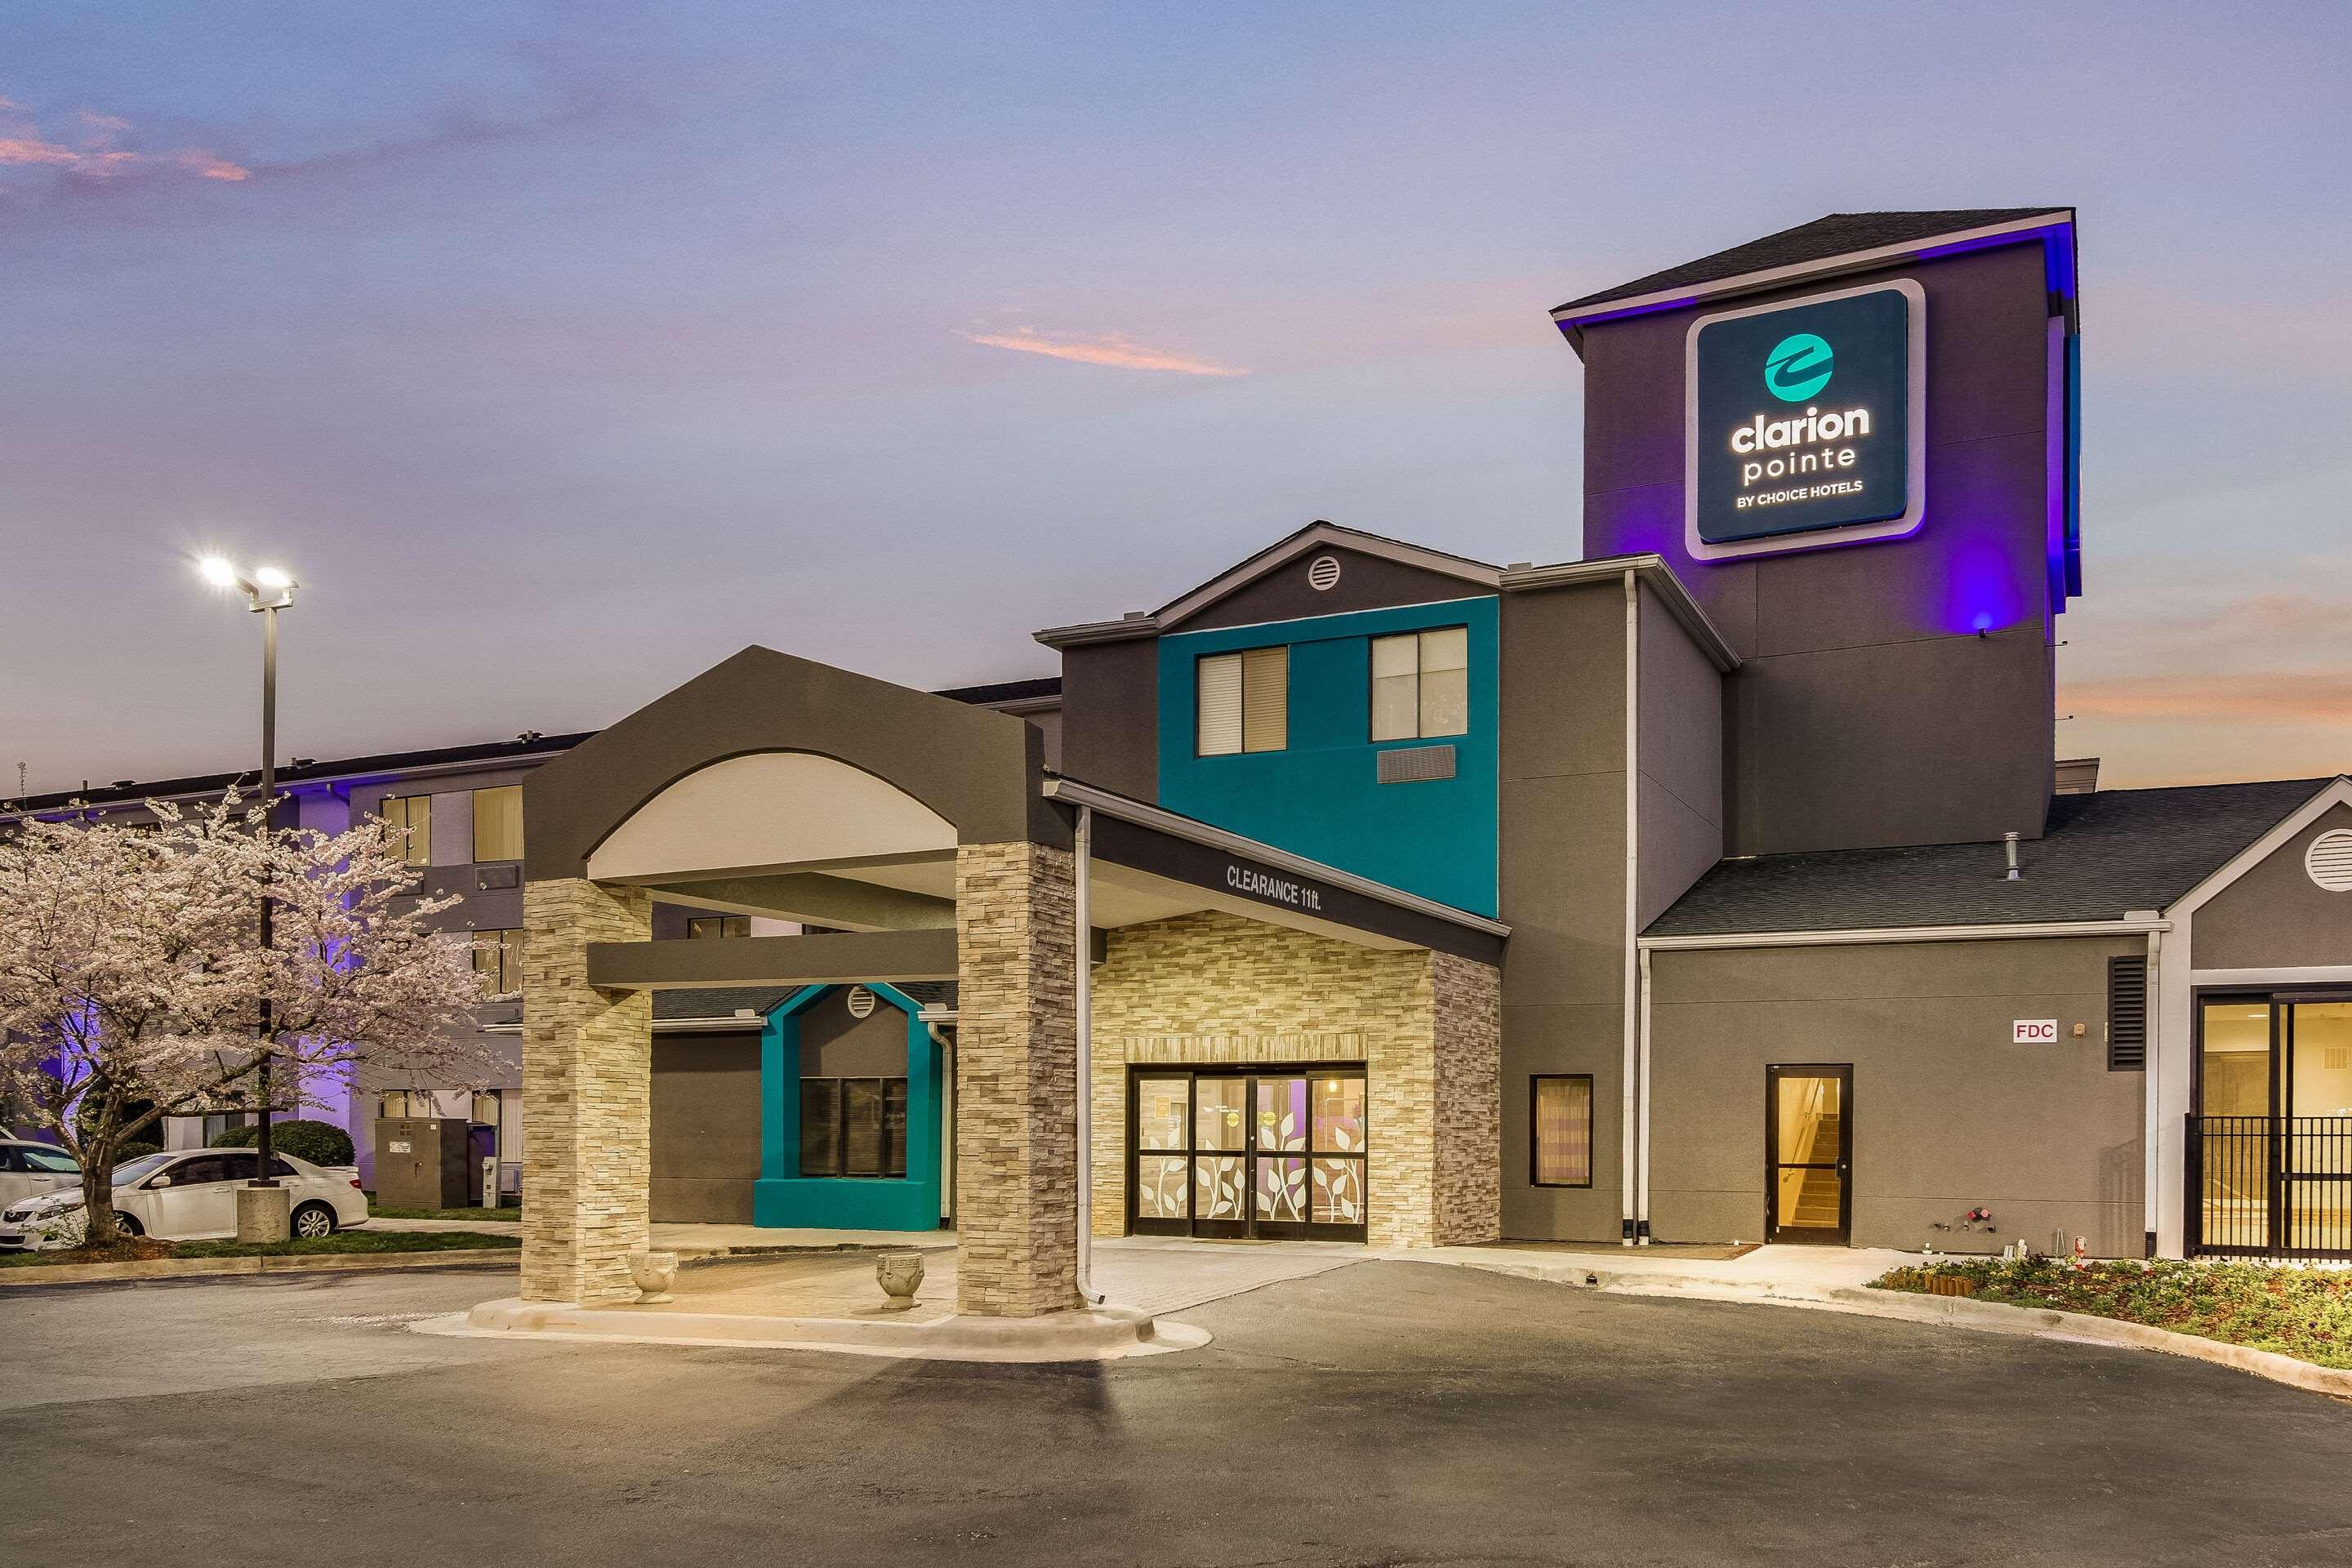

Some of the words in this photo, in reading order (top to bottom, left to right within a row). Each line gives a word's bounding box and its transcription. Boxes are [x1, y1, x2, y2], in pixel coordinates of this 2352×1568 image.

[1731, 407, 1869, 453] clarion
[1744, 448, 1855, 487] pointe
[1737, 495, 1755, 508] BY
[1757, 488, 1808, 506] CHOICE
[1811, 480, 1863, 497] HOTELS
[1227, 865, 1298, 904] CLEARANCE
[1301, 887, 1321, 911] 11ft.
[2016, 1024, 2054, 1038] FDC
